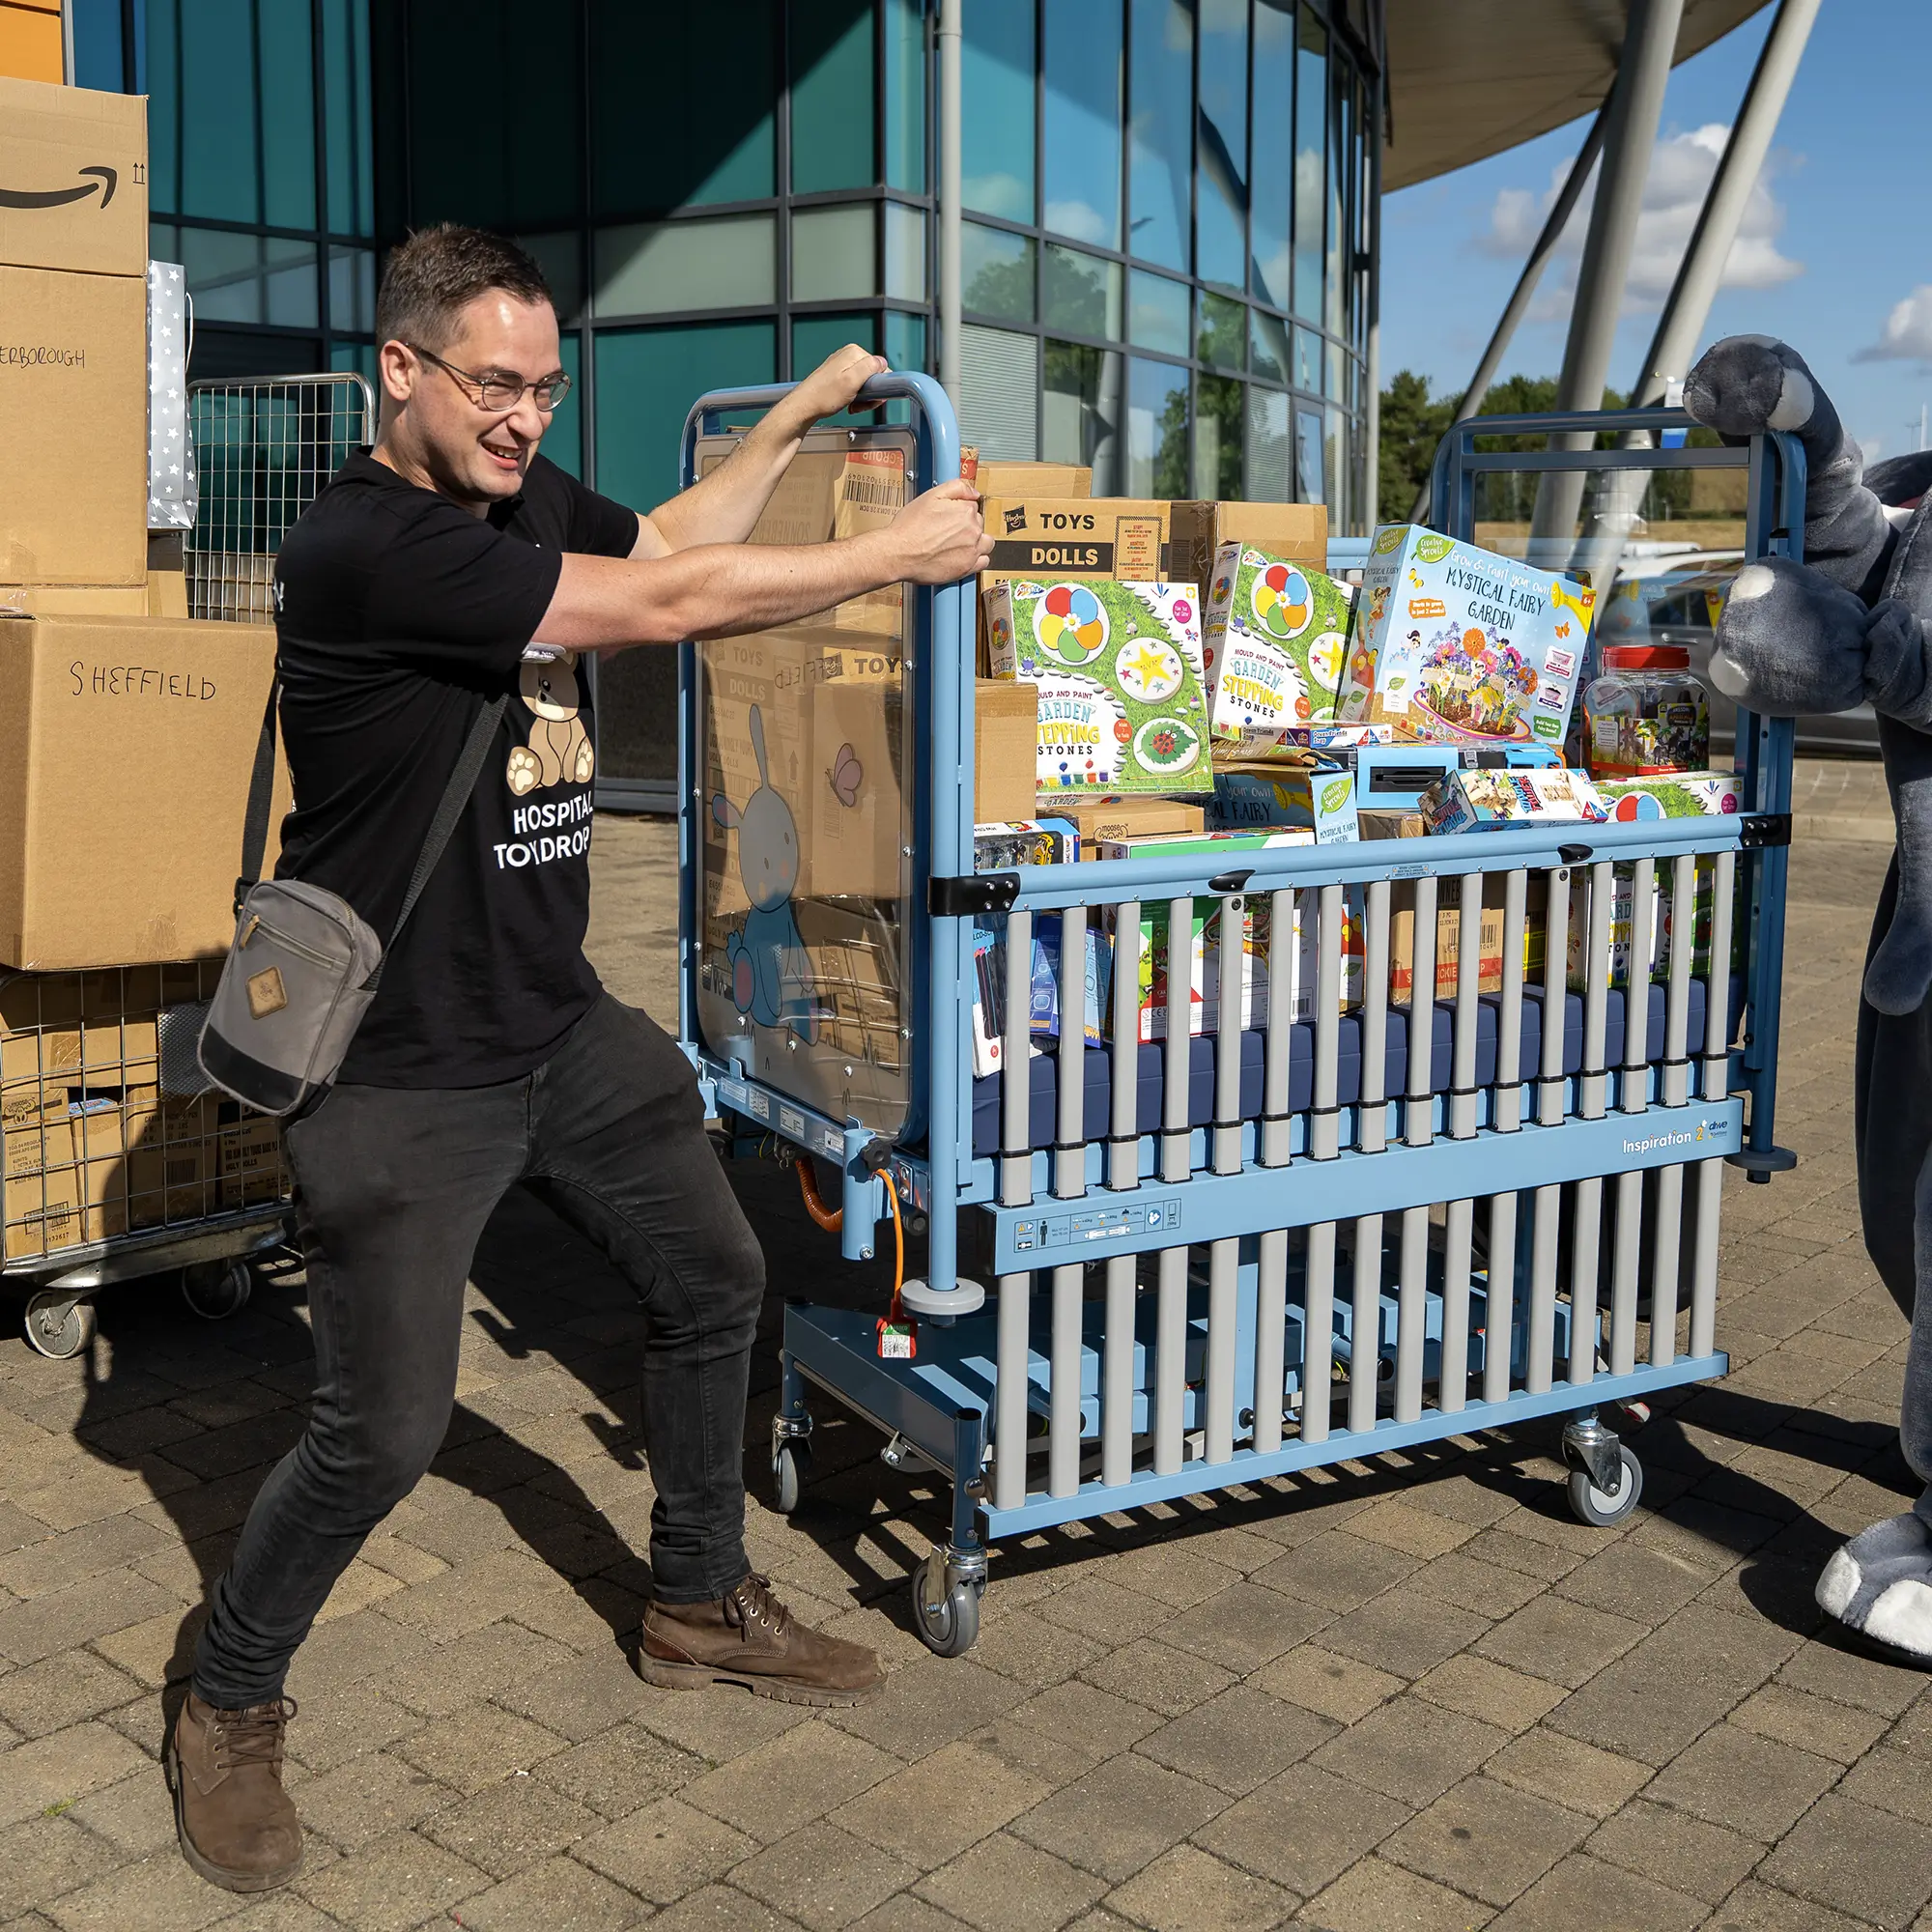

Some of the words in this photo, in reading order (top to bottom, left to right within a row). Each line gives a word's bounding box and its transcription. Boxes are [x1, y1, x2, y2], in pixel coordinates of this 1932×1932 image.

[1039, 514, 1095, 530] TOYS
[1420, 537, 1443, 547] Creative
[1420, 547, 1443, 558] Sprouts
[1031, 548, 1099, 566] DOLLS
[1450, 549, 1472, 570] Grow
[1445, 566, 1504, 604] MYSTICAL
[1508, 588, 1547, 616] FAIRY
[1467, 600, 1516, 631] GARDEN
[732, 646, 764, 668] TOYS
[854, 657, 906, 674] TOY
[1235, 648, 1254, 658] MOULD
[1255, 654, 1267, 663] AND
[1268, 658, 1285, 671] PAINT
[70, 661, 216, 700] SHEFFIELD
[1234, 660, 1282, 691] GARDEN
[729, 677, 766, 701] DOLLS
[1037, 691, 1054, 699] OULD
[1056, 690, 1070, 698] AND
[1072, 691, 1094, 700] PAINT
[1230, 696, 1275, 719] STONES
[1037, 745, 1094, 755] STONES
[1324, 789, 1346, 811] Sprouts
[513, 790, 594, 834] HOSPITAL
[1231, 802, 1271, 822] FAIRY
[1101, 823, 1122, 832] moose
[493, 825, 590, 869] TOYDROP
[1618, 892, 1632, 900] AND
[1623, 1129, 1692, 1155] Inspiration
[1695, 1125, 1704, 1141] 2
